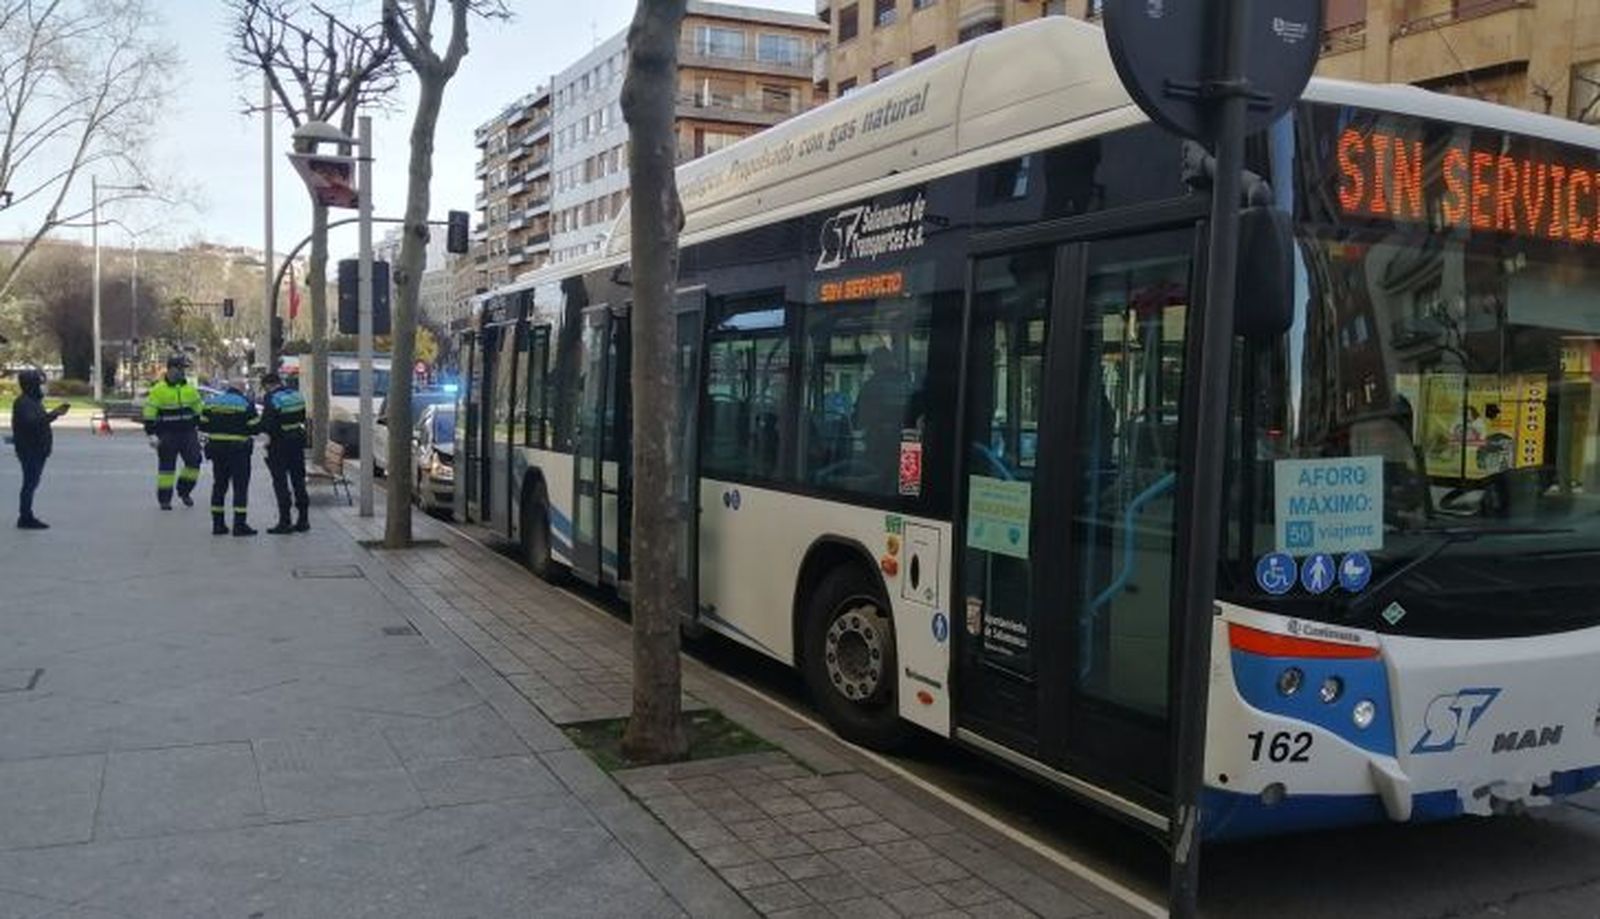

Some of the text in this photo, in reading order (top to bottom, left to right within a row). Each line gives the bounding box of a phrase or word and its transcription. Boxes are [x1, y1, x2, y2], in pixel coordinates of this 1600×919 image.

[798, 132, 824, 156] con
[827, 119, 856, 151] gas
[861, 82, 931, 133] natural
[1338, 128, 1423, 218] SIN
[861, 193, 926, 234] Salamanca de
[1297, 466, 1367, 487] AFORO
[1248, 731, 1313, 763] 162
[1491, 725, 1564, 754] MAN
